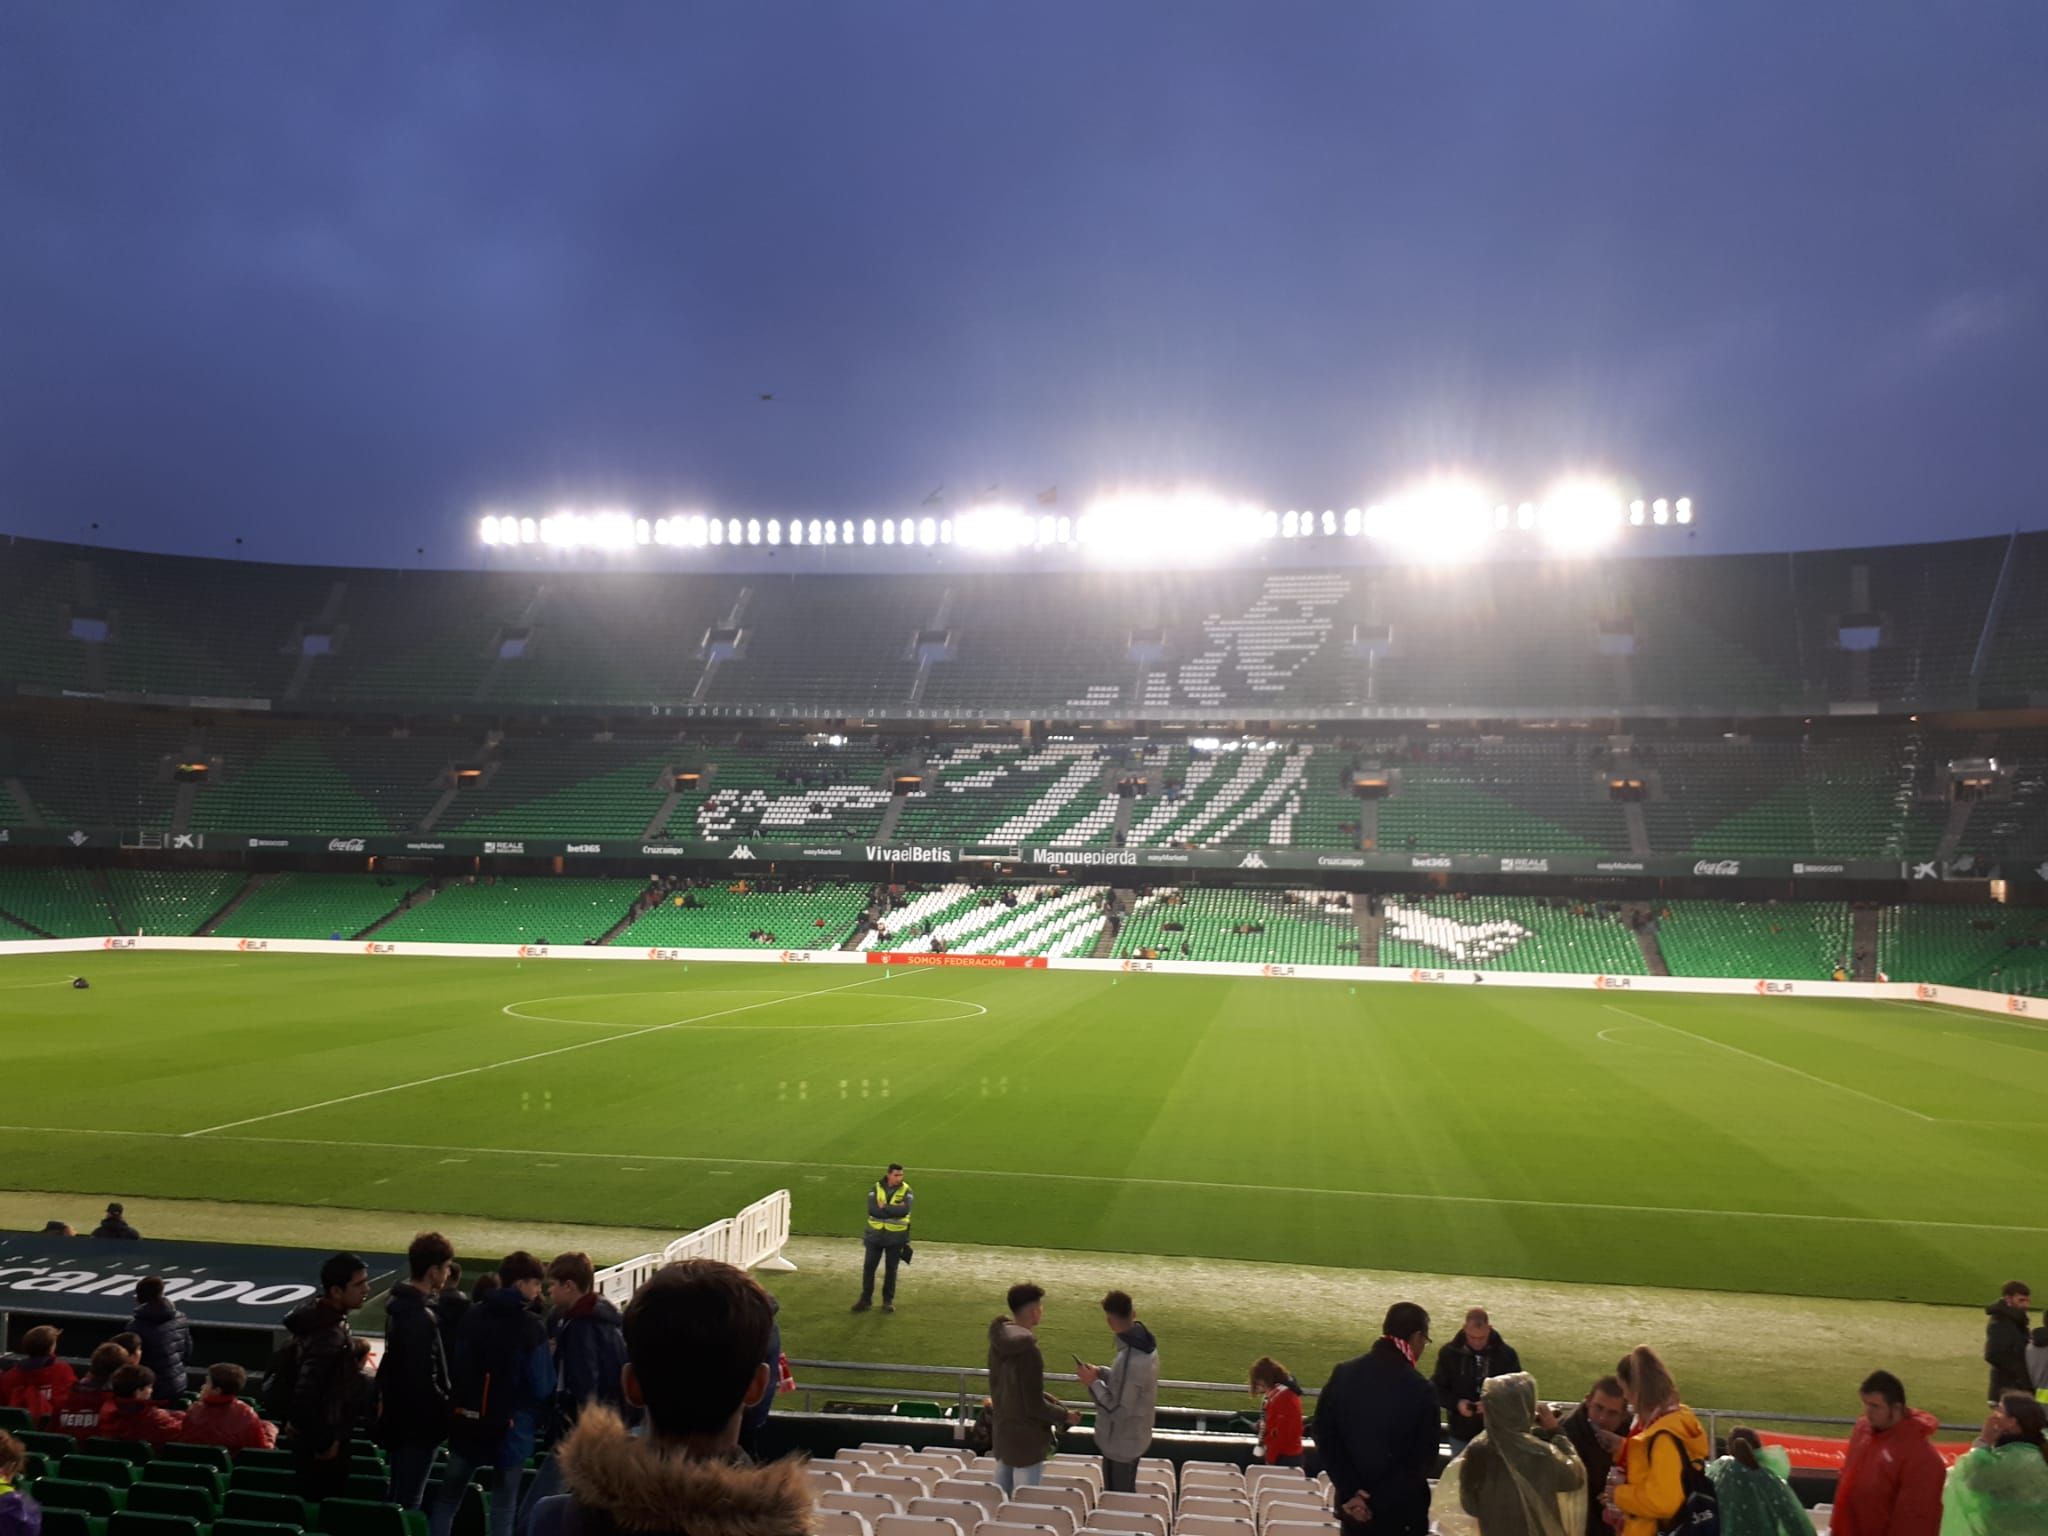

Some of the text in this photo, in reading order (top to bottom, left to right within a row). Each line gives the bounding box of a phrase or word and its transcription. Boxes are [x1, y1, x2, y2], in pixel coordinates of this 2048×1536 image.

[652, 705, 671, 716] De
[687, 706, 755, 718] padres
[867, 708, 887, 718] de
[905, 709, 984, 719] abuelos
[567, 843, 601, 853] bet365
[642, 844, 684, 856] Cruzcampo
[1318, 856, 1365, 867] Cruzcampo
[1412, 857, 1451, 867] bet365
[111, 939, 135, 948] ELA
[246, 941, 268, 950] ELA
[373, 944, 395, 953] ELA
[526, 947, 548, 956] ELA
[656, 950, 678, 960] ELA
[789, 952, 810, 962] ELA
[908, 956, 1006, 968] SOMOS FEDERACIÓN
[1131, 961, 1153, 971] ELA
[1272, 967, 1295, 976] ELA
[1420, 971, 1445, 981] ELA
[1604, 977, 1631, 988] ELA
[1766, 982, 1793, 993] ELA
